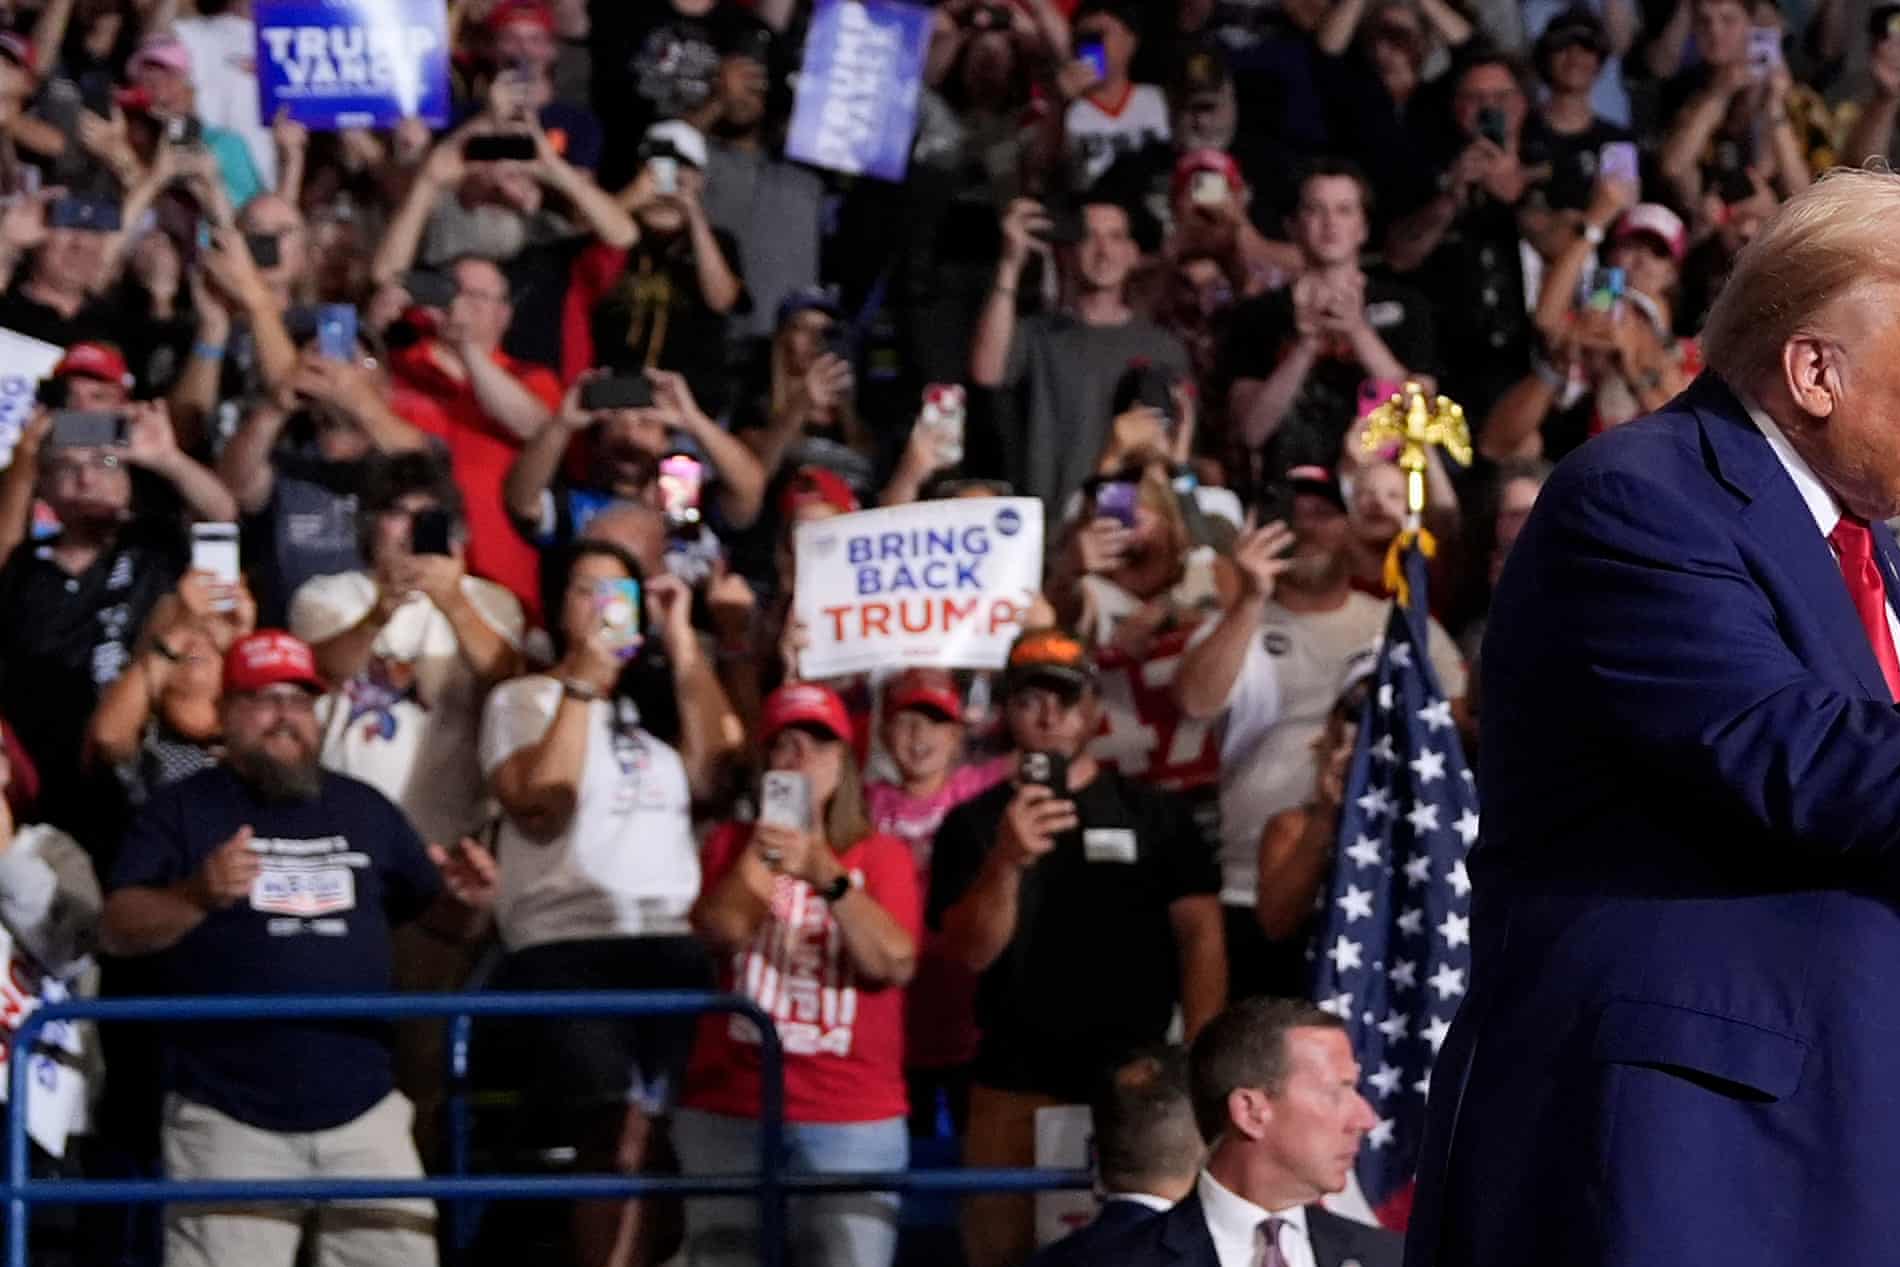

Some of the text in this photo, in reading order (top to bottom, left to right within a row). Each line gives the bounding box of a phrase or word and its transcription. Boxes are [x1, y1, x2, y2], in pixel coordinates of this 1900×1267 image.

[262, 26, 437, 62] TRUP
[282, 55, 420, 83] VANC
[847, 525, 991, 564] BRING
[857, 558, 983, 595] BACK
[823, 597, 1019, 642] TRUMP
